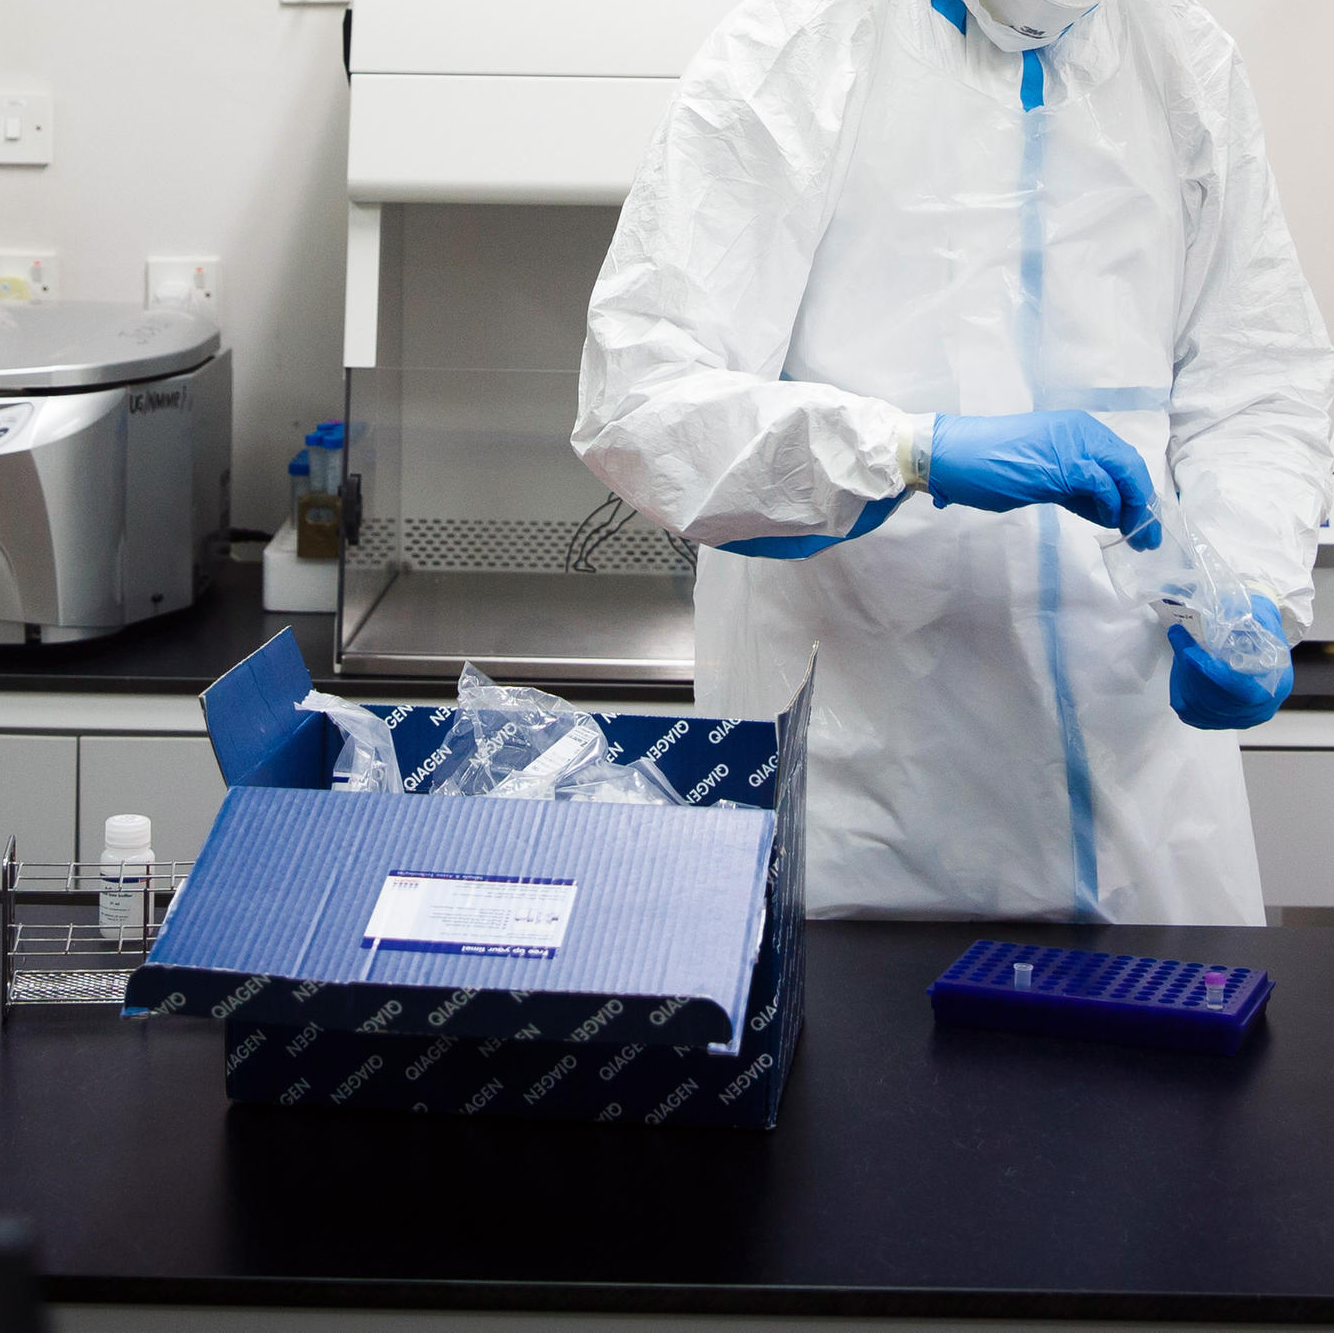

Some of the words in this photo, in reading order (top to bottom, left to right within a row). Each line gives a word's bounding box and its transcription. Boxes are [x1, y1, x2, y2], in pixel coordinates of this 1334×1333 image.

[708, 718, 742, 745] QIAG
[403, 744, 453, 791] QIAGEN
[748, 751, 779, 788] QIAG
[513, 947, 527, 955] up
[528, 948, 549, 956] Free
[153, 991, 187, 1016] QIA
[211, 974, 272, 1019] QIAGEN
[428, 985, 481, 1027] QIAGE
[649, 994, 690, 1026] QIAG
[356, 999, 403, 1033] QIAG
[226, 1028, 268, 1077] IAGEN
[286, 1021, 324, 1058] GEN
[330, 1054, 384, 1106] QIAGEN
[523, 1054, 578, 1106] QIAGEN
[598, 1042, 647, 1081] QIAGE
[718, 1053, 774, 1106] QIAGEN
[279, 1076, 312, 1107] GEN
[458, 1076, 505, 1116] AGEN
